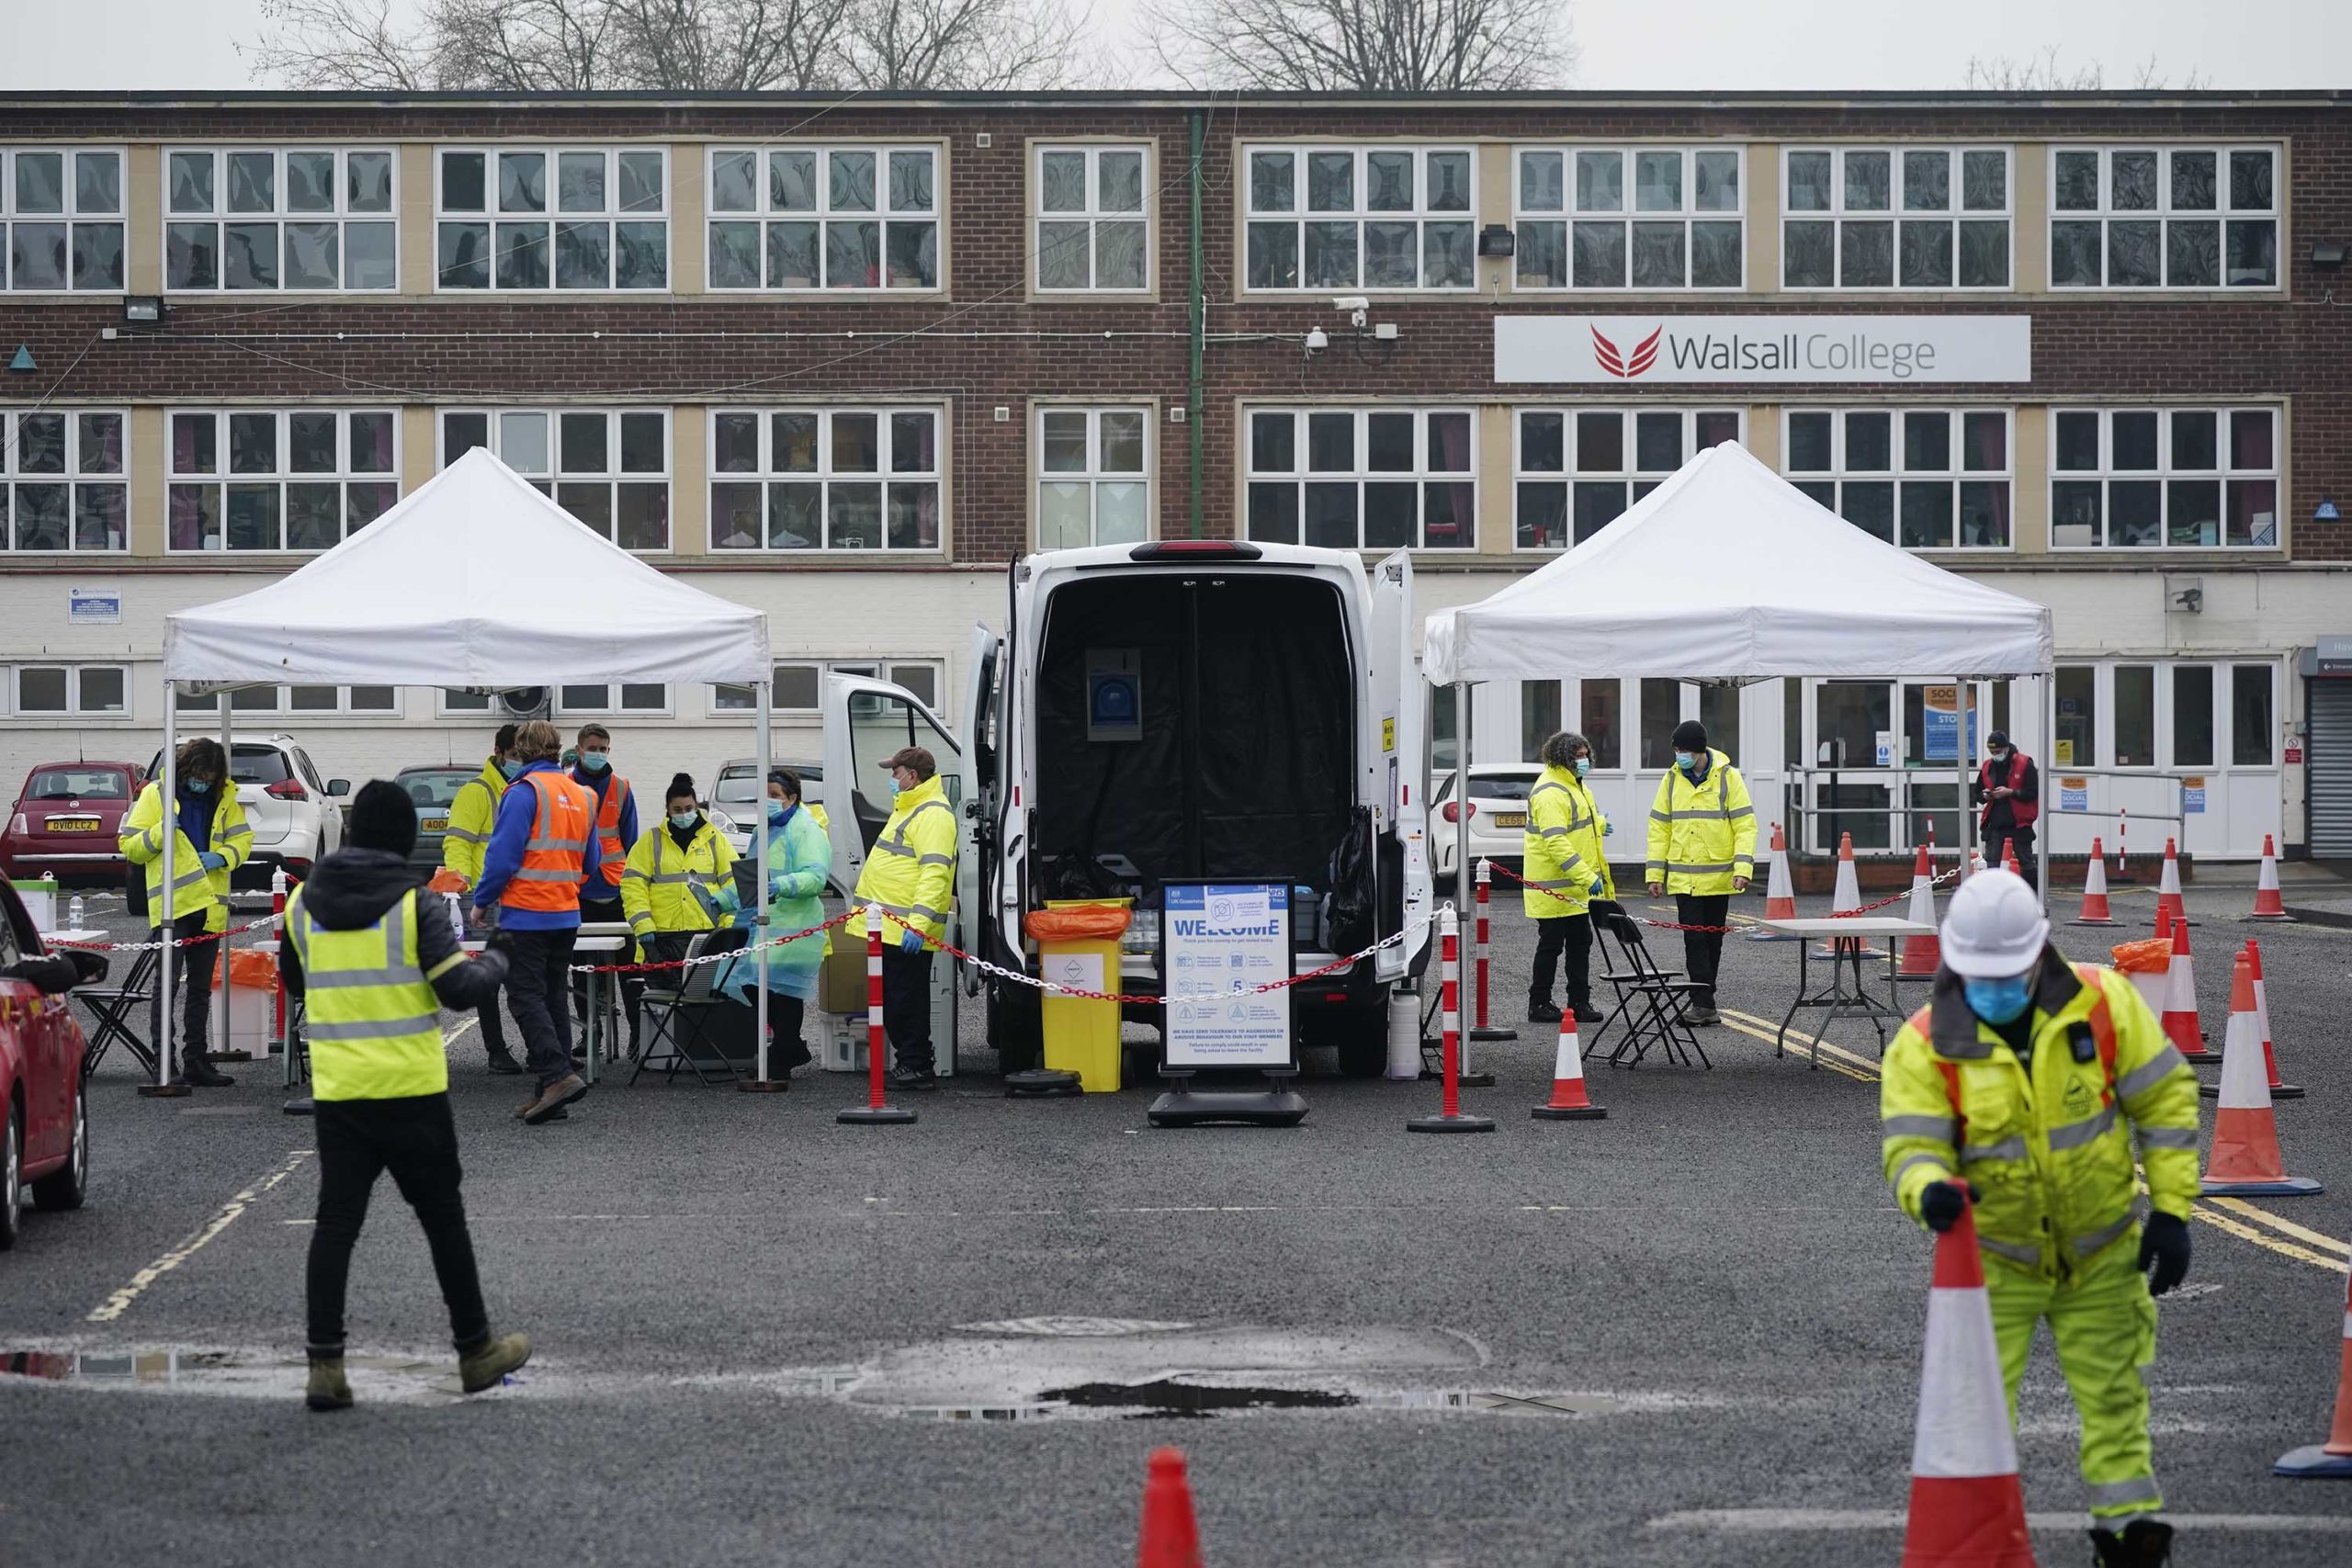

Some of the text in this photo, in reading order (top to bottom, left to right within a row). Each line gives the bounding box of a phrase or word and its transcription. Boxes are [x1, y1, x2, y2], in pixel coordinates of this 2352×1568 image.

[1669, 333, 1936, 378] Walsall College
[1931, 689, 1957, 698] SOCI
[1939, 715, 1957, 724] STO
[1233, 980, 1242, 992] 5
